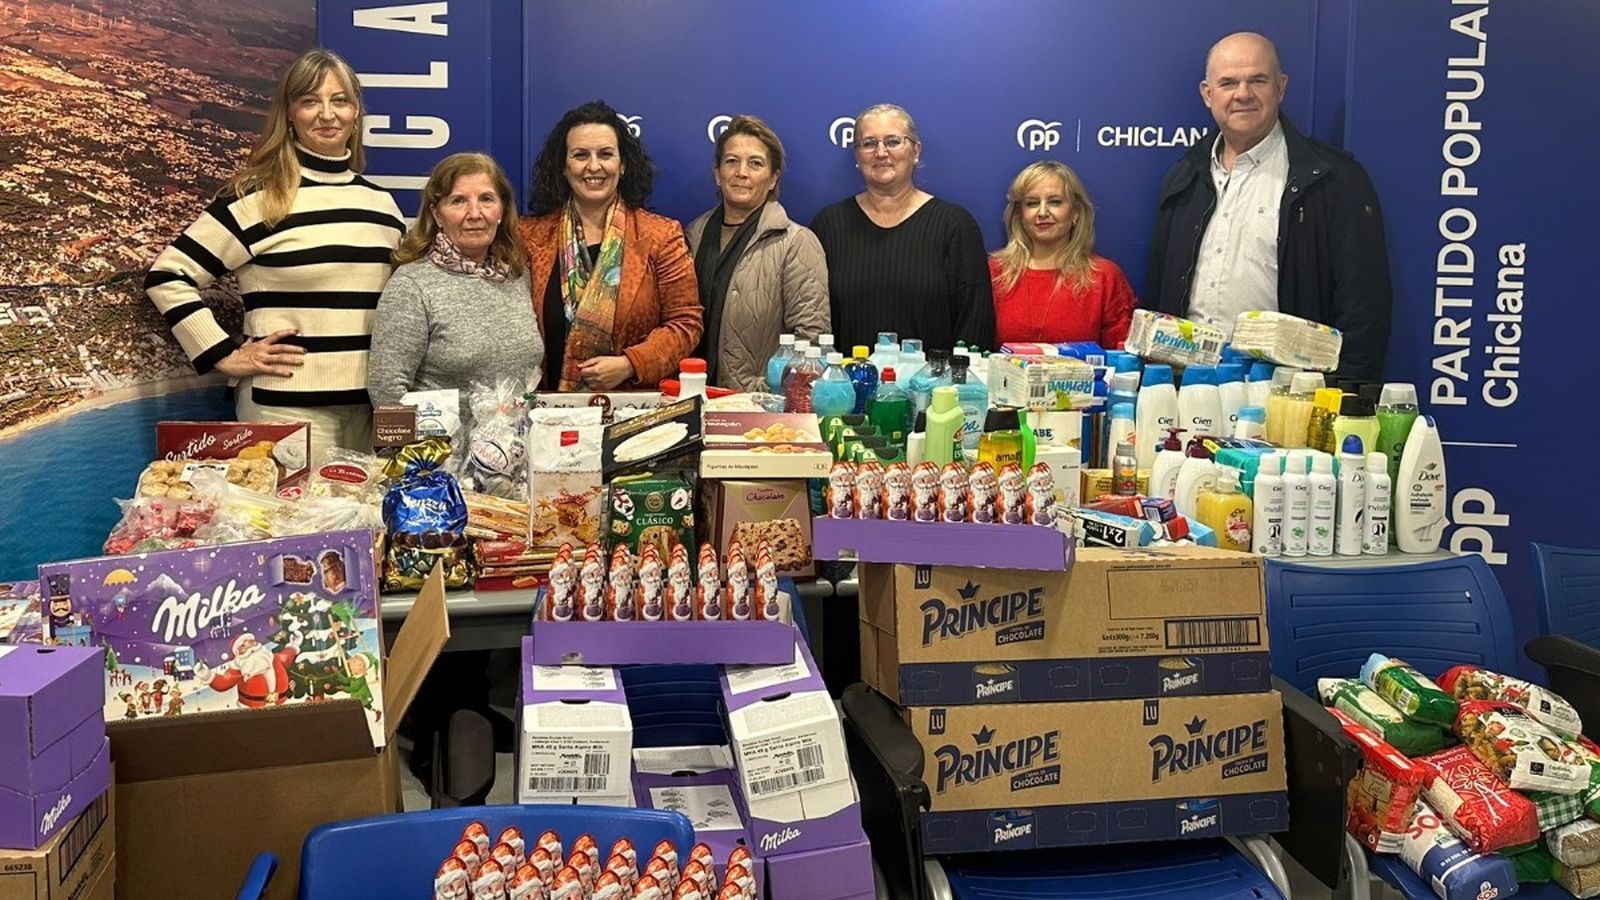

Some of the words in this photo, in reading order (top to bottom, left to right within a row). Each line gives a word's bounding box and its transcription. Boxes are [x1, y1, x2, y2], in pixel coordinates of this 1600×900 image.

[1441, 0, 1489, 196] POPULA
[353, 2, 450, 230] ICLA
[1430, 208, 1478, 405] PARTIDO
[1482, 243, 1526, 408] Chiclana
[1192, 417, 1213, 426] Cien
[1418, 471, 1441, 481] Dove
[1450, 487, 1510, 565] pp
[917, 569, 930, 585] LU
[151, 578, 266, 644] Milka
[997, 626, 1043, 644] CHOCOLATE
[931, 714, 944, 730] LU
[1145, 705, 1158, 720] LU
[1223, 759, 1266, 777] CHOCOLATE
[1013, 771, 1059, 790] CHOCOLATE
[40, 794, 72, 835] Milka
[760, 827, 802, 851] Milka
